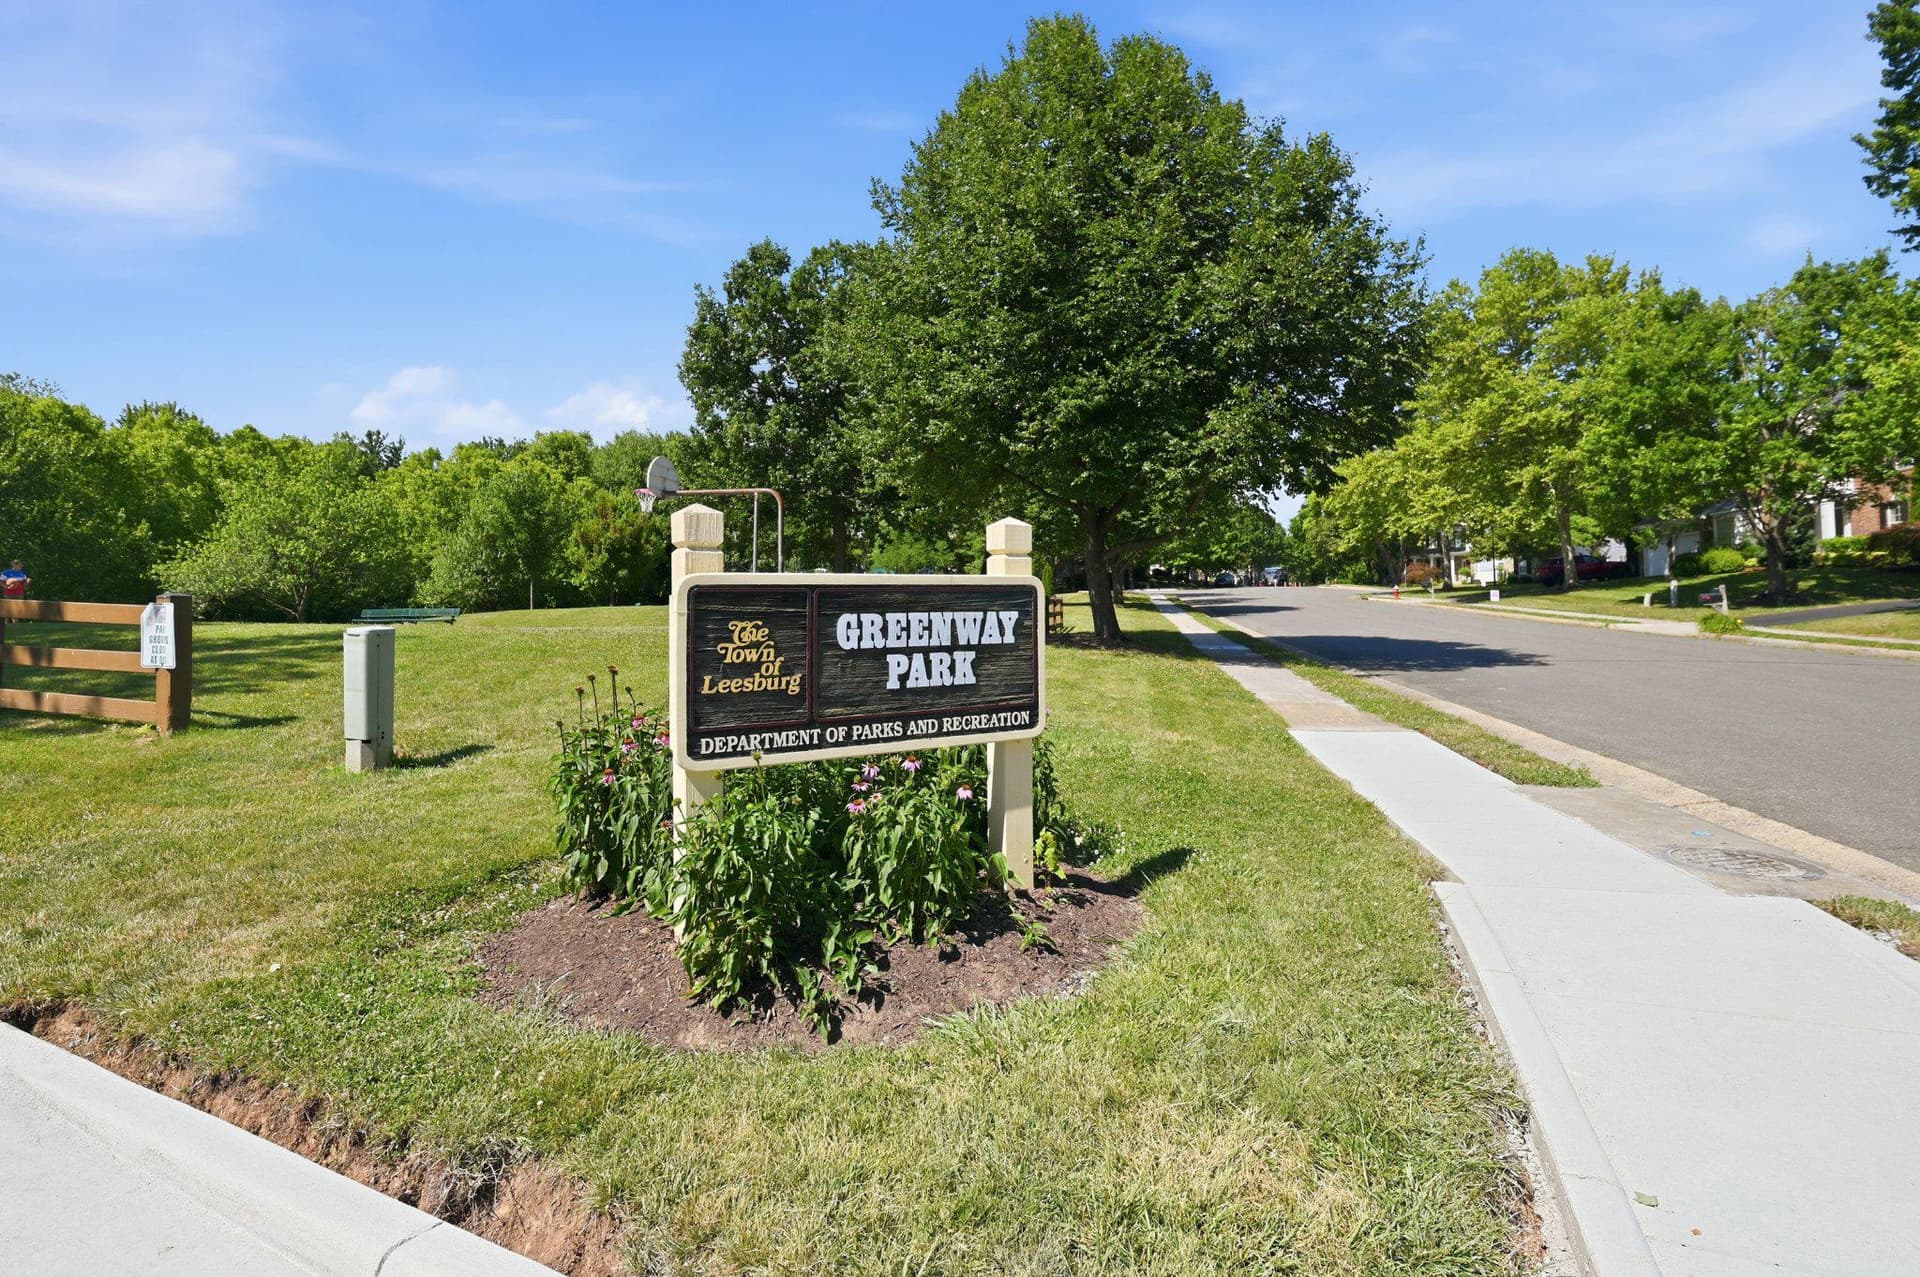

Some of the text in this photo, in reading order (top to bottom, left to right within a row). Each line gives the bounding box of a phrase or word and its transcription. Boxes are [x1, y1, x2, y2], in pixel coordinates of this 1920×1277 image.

[728, 620, 769, 647] The
[836, 611, 1019, 650] GREENWAY
[717, 641, 775, 663] Town
[760, 656, 784, 676] of
[886, 651, 977, 690] PARK
[701, 672, 802, 695] Leesburg
[700, 711, 1031, 755] DEPARTMENT OF PARKS AND RECREATION
